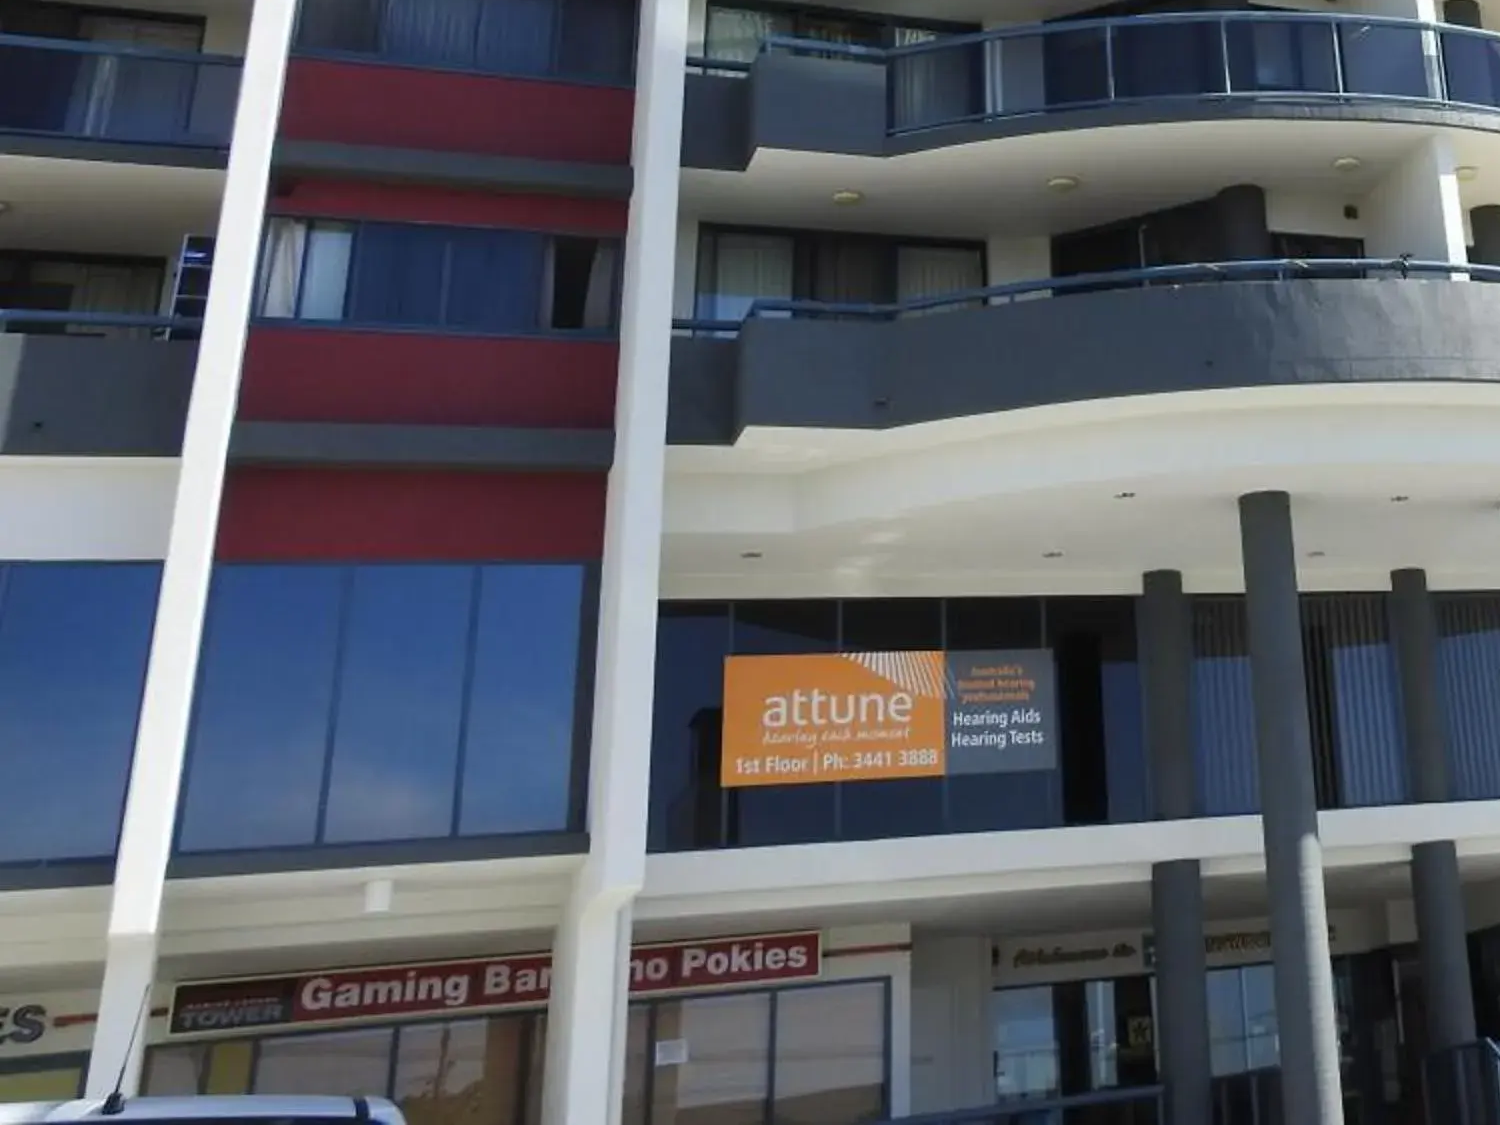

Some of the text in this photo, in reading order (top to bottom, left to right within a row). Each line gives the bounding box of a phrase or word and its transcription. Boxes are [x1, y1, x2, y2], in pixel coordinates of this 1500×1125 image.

[762, 687, 913, 728] attune
[953, 708, 1041, 728] Hearing Aids
[951, 729, 1044, 750] Hearing Tests
[735, 757, 760, 775] 1st
[765, 755, 808, 773] Floor
[823, 753, 850, 771] Ph:
[854, 752, 892, 770] 3441
[301, 970, 470, 1010] Gaming
[681, 941, 808, 978] Pokies
[179, 1003, 284, 1030] TOWER
